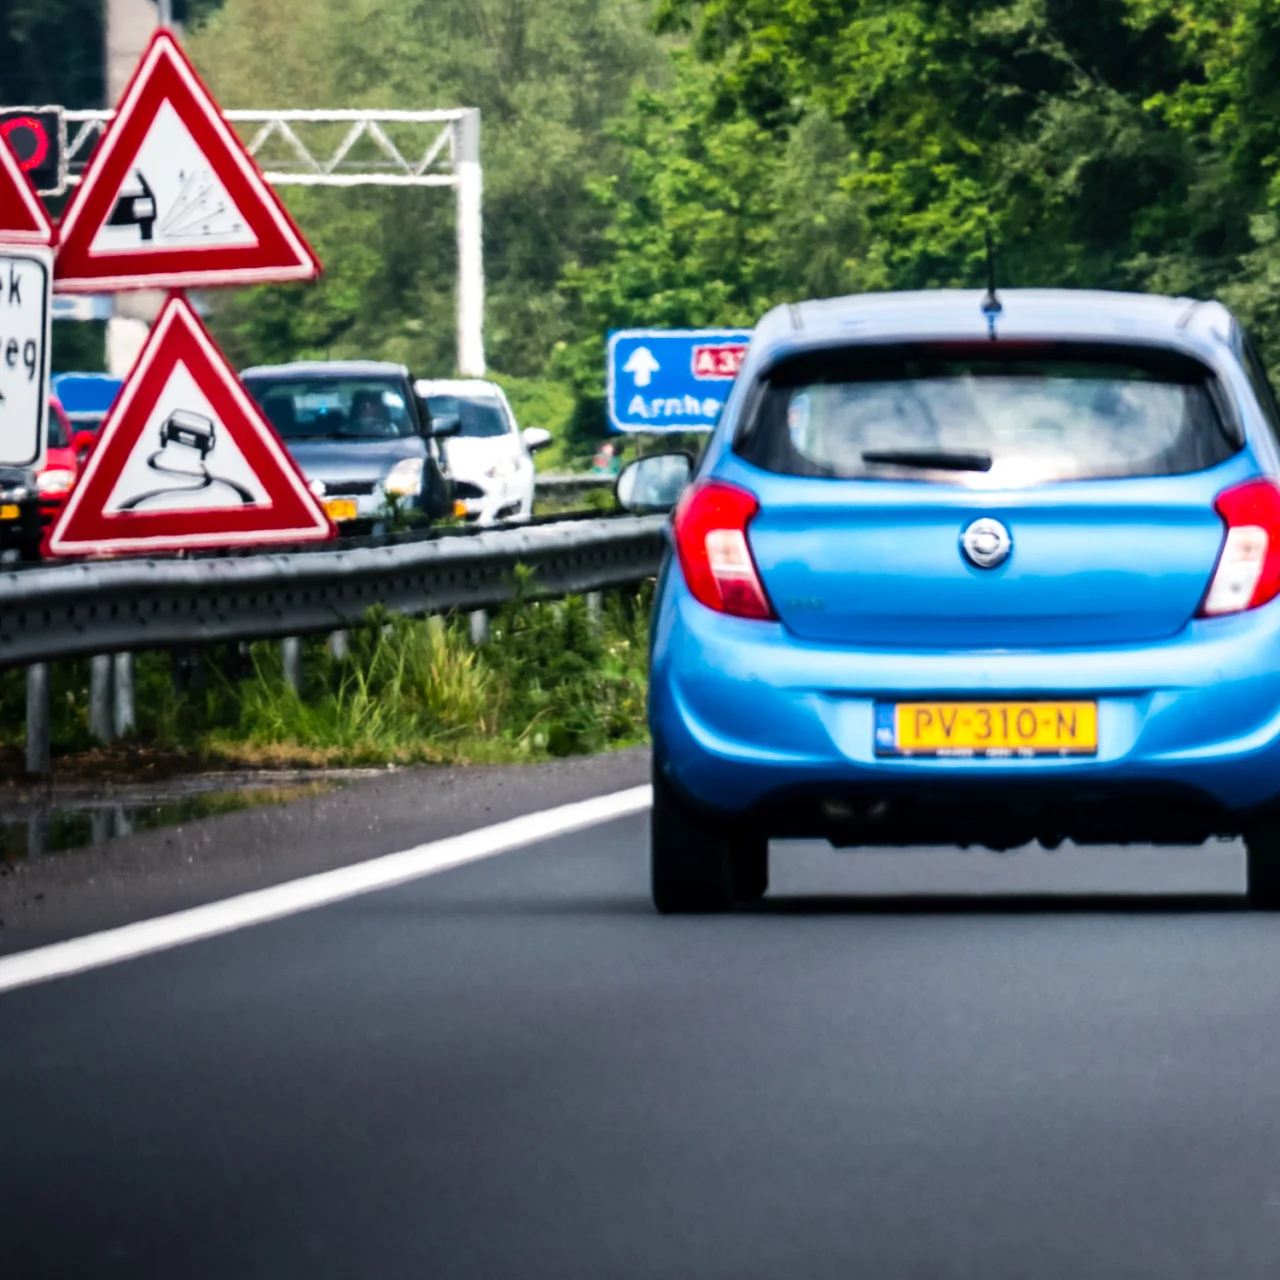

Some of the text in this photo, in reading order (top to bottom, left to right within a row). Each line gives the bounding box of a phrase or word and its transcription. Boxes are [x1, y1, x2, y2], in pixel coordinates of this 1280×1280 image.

[0, 337, 37, 381] eg
[628, 393, 725, 418] Arnhe
[914, 707, 1078, 740] PV-310-N
